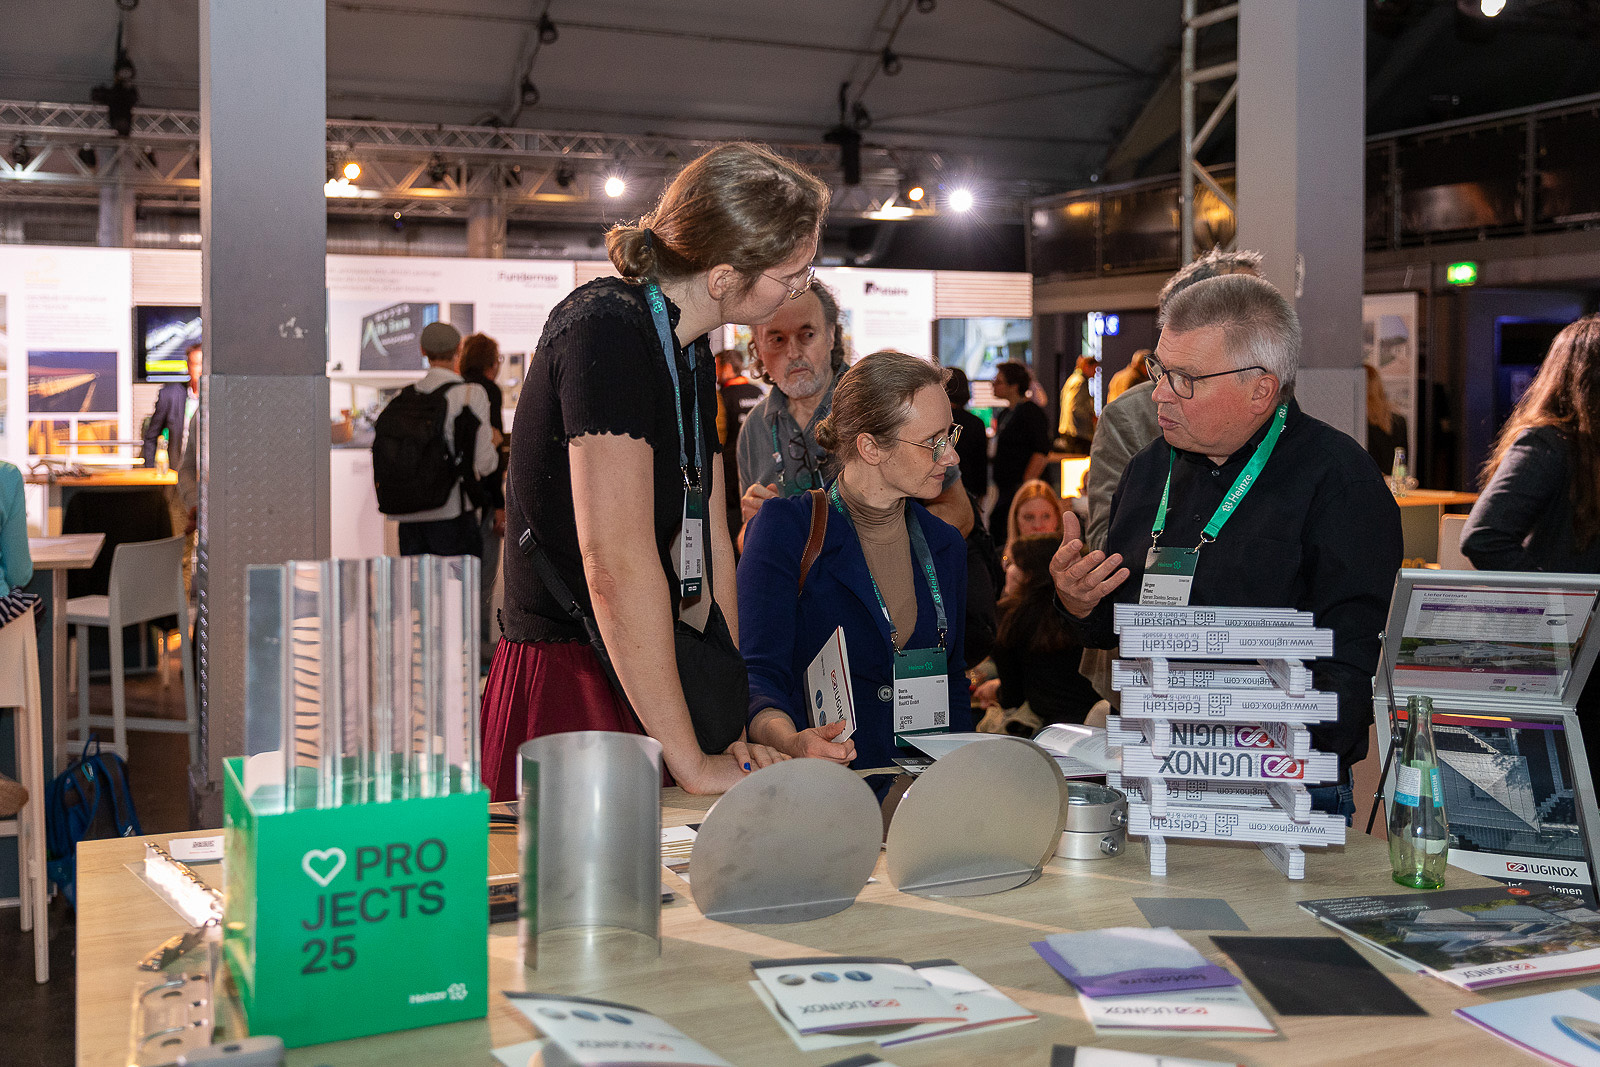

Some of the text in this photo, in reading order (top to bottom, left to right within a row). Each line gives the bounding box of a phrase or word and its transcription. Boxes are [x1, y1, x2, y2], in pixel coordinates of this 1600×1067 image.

[1228, 473, 1253, 503] Heinze
[831, 486, 844, 513] Heinze
[925, 564, 940, 594] Heinze
[1142, 632, 1167, 640] Fassade
[1142, 638, 1314, 652] Edelstahl www.uginox.com
[1143, 701, 1318, 714] Edelstahl www.uginox.com
[1158, 750, 1253, 777] UGINOX
[1431, 774, 1441, 802] MEDIUM
[1150, 817, 1326, 834] Edelstahl www.uginox.com
[355, 838, 448, 881] PRO
[1531, 864, 1579, 878] UGINOX
[301, 880, 445, 931] JECTS
[301, 934, 357, 975] 25
[1457, 964, 1512, 979] UGINOX
[800, 1000, 867, 1014] UGINOX
[1104, 1006, 1172, 1015] UGINOX
